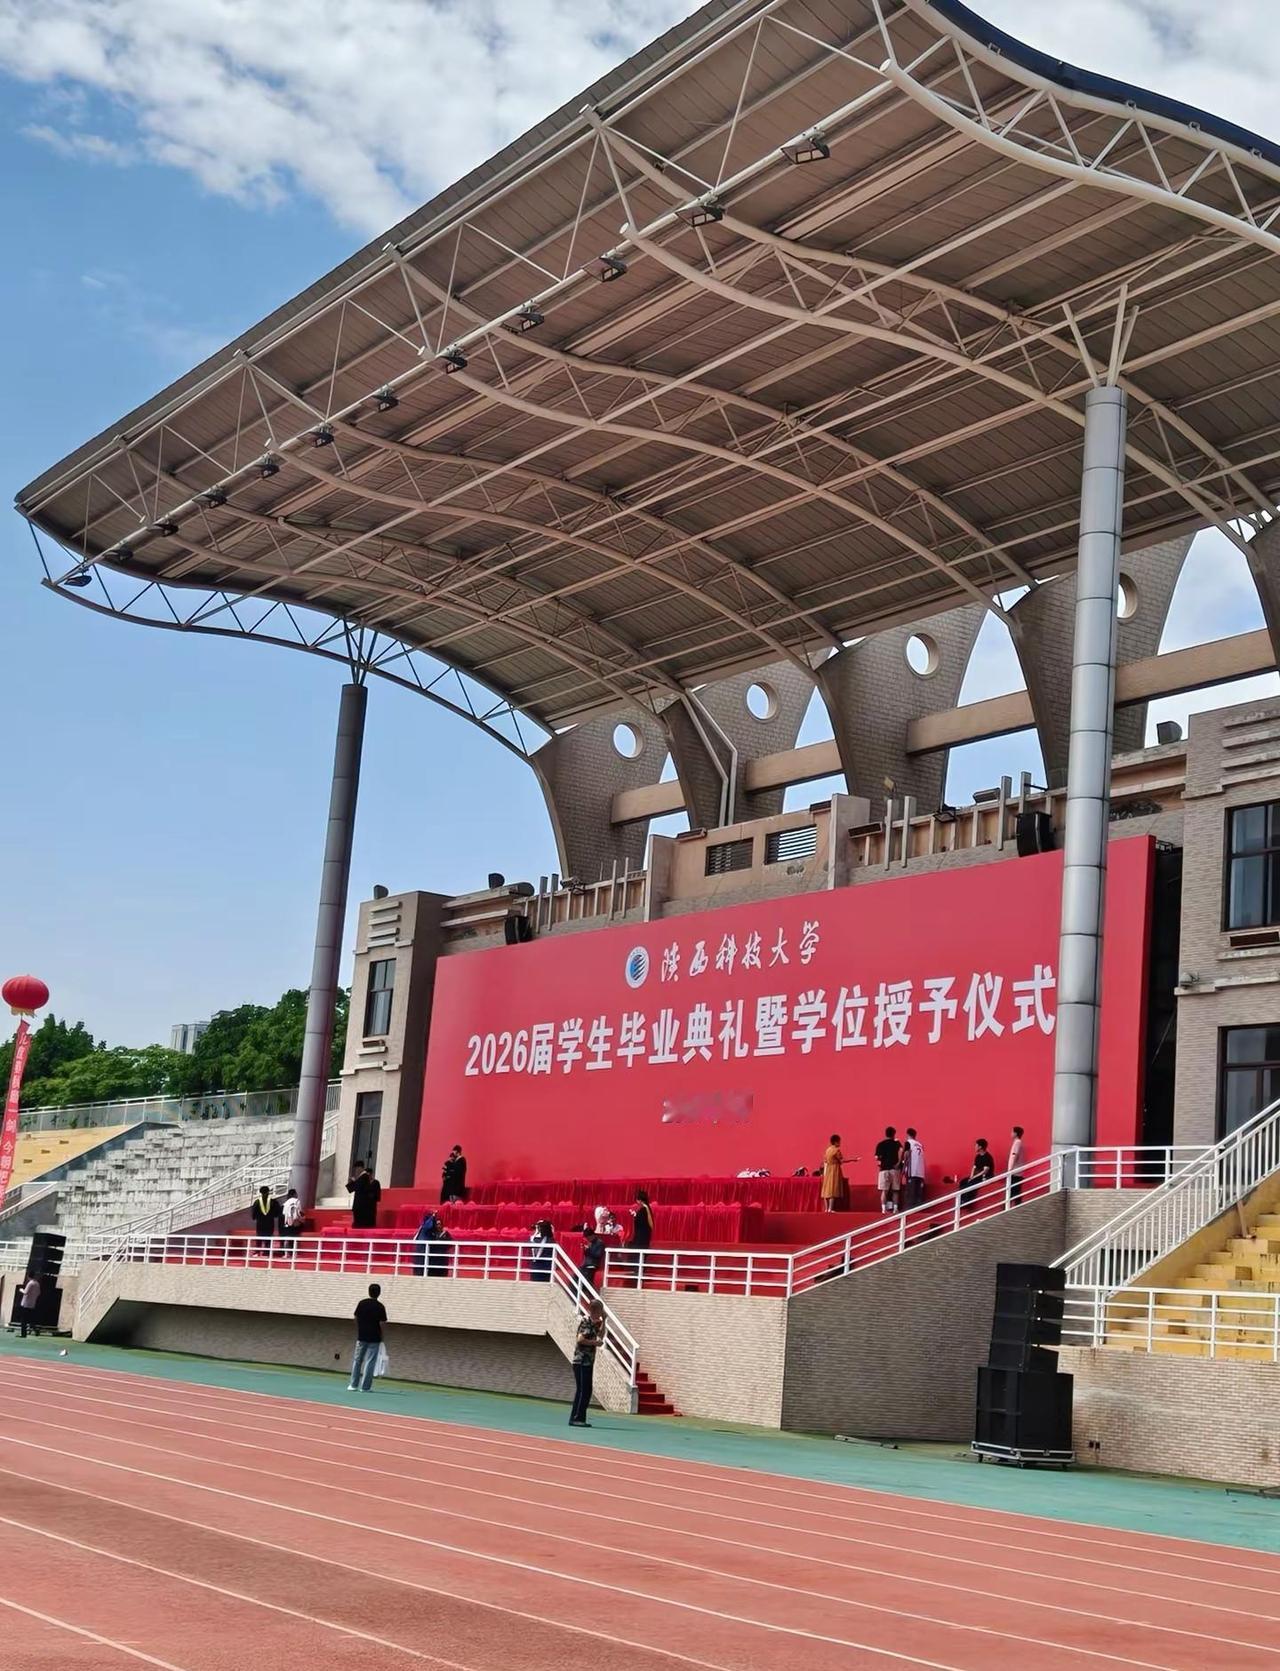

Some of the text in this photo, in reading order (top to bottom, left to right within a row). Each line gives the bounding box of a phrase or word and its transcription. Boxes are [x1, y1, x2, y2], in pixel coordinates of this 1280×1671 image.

[661, 921, 819, 982] 陕西科技大学
[465, 964, 1056, 1076] 2026届学生毕业典礼暨学位授予仪式
